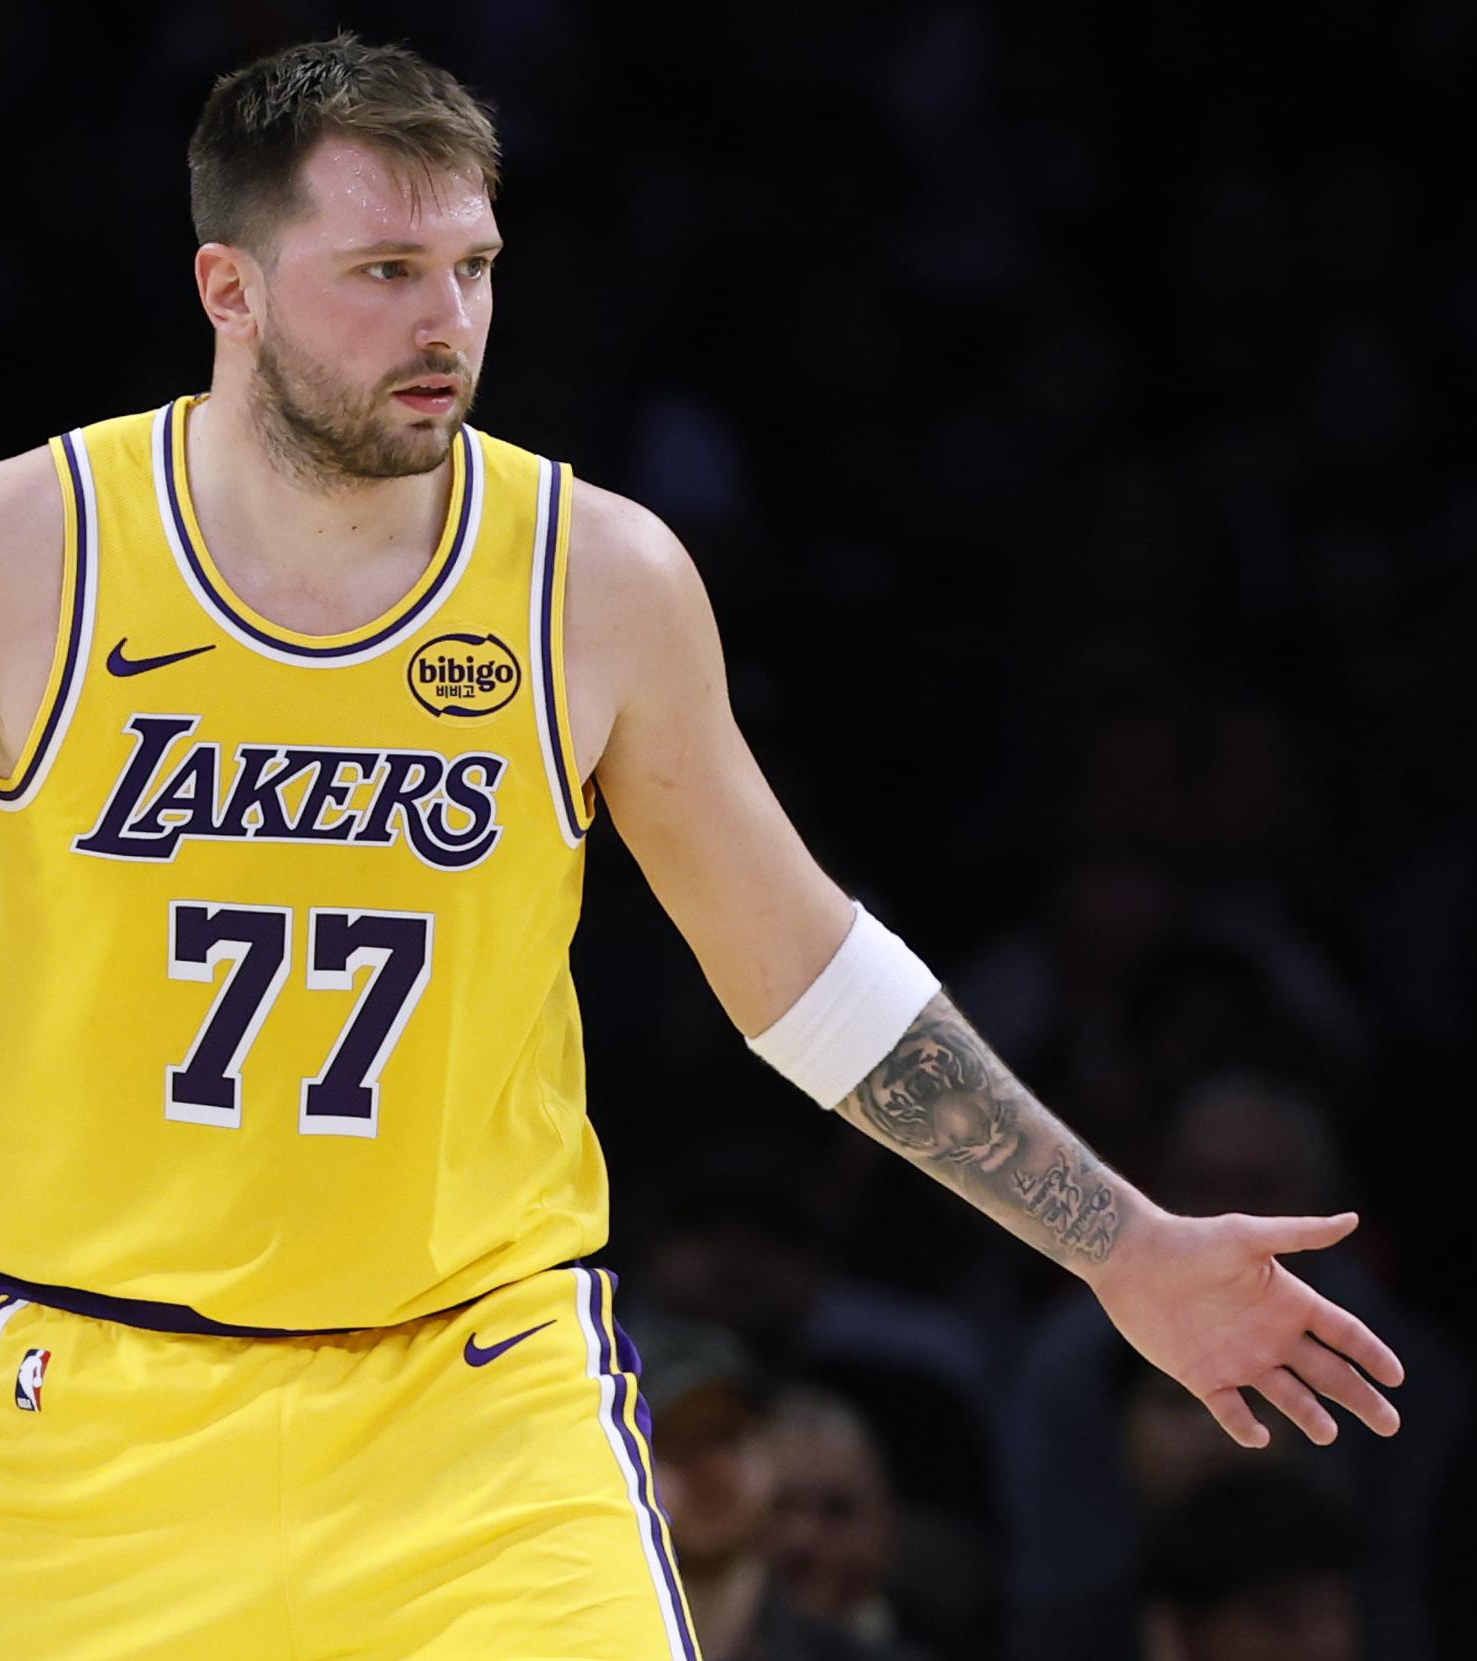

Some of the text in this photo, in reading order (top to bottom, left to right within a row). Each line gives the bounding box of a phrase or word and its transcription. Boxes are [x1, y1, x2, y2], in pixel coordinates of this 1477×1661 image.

[419, 655, 514, 693] bibigo
[436, 685, 476, 699] 비비고
[71, 713, 508, 871] LAKERS
[165, 900, 434, 1138] 77
